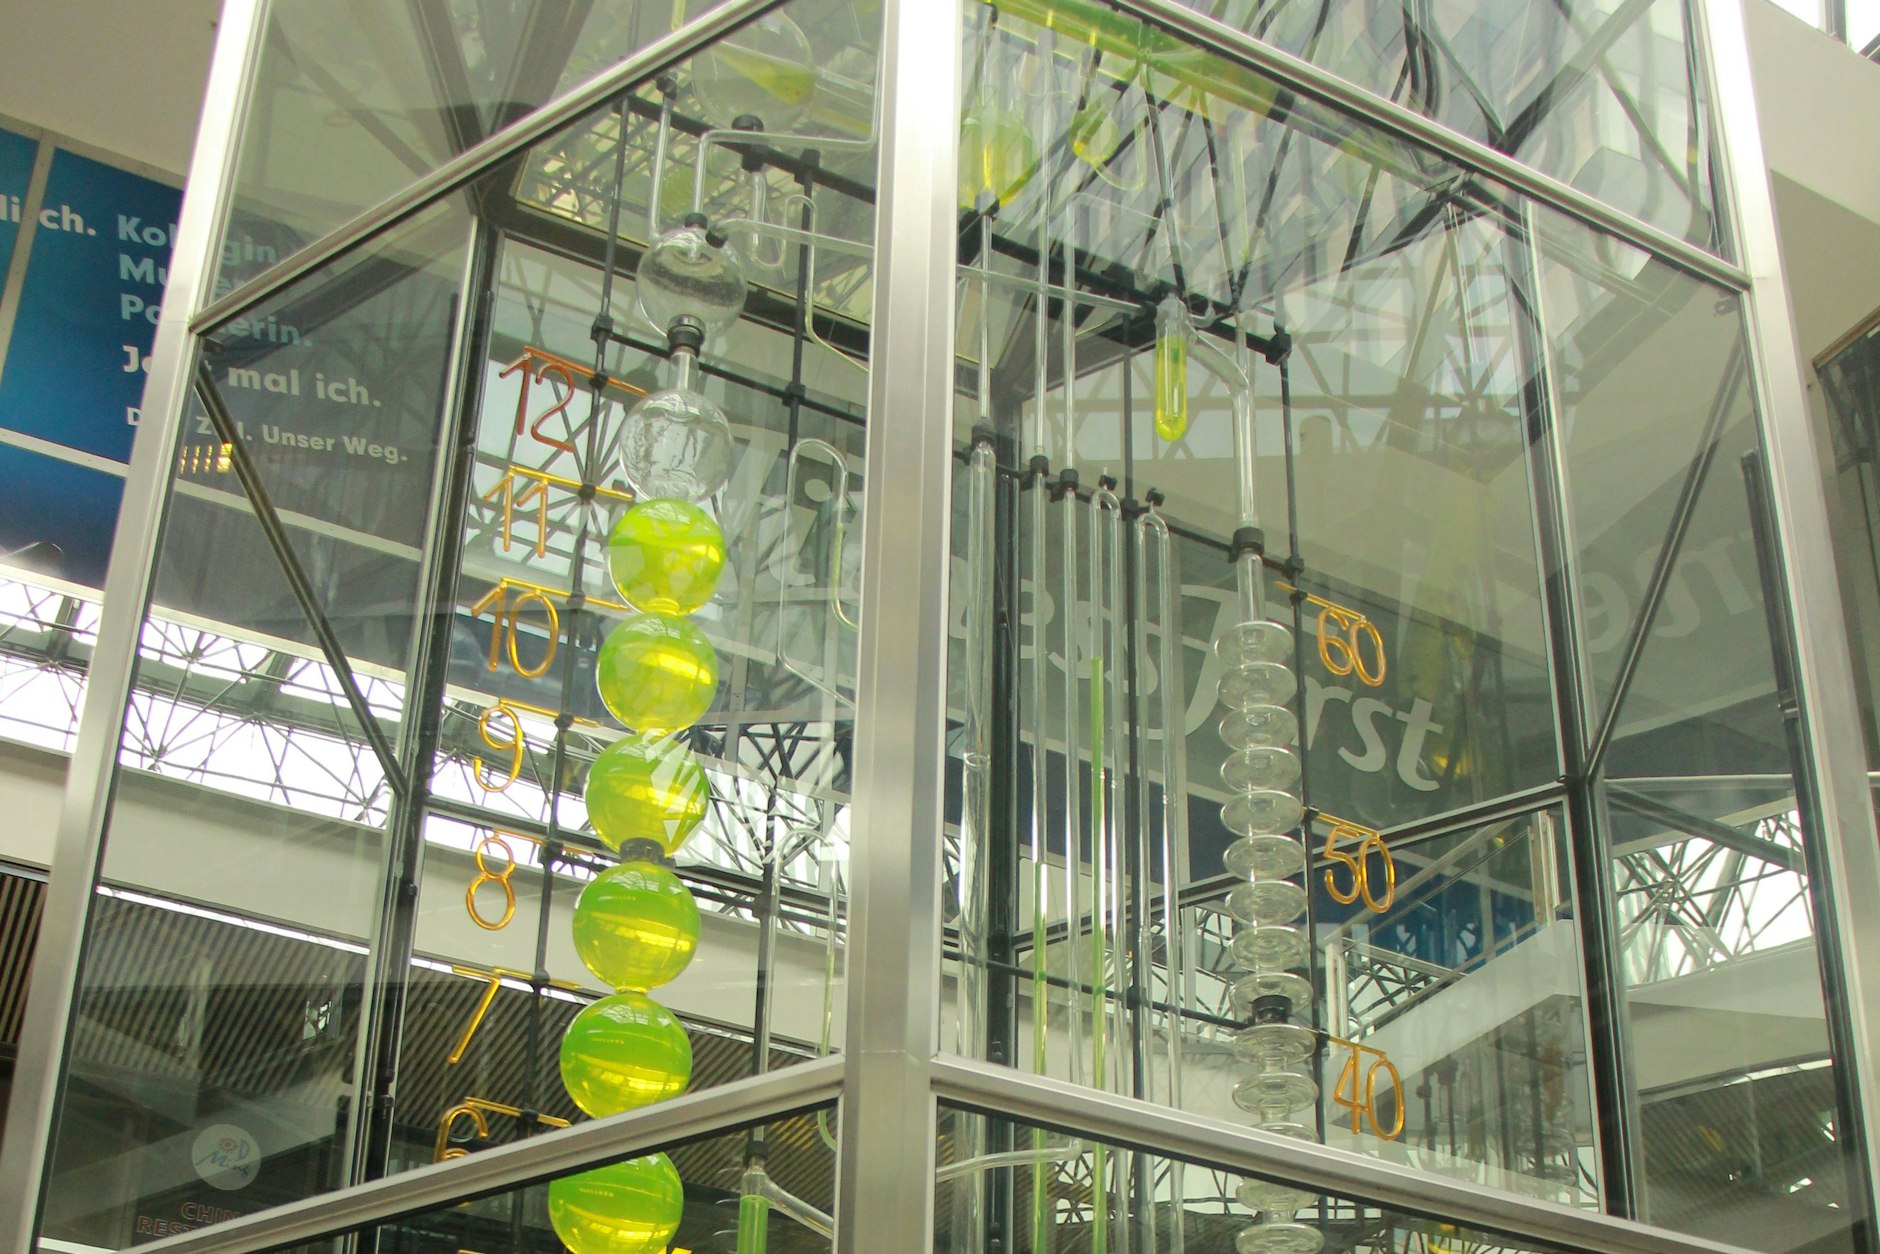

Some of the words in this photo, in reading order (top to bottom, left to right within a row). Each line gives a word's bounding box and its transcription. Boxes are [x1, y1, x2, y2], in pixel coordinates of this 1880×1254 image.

[227, 366, 300, 396] mal
[315, 373, 382, 408] ich.
[499, 352, 575, 453] 12
[262, 424, 336, 452] Unser
[342, 435, 408, 465] Weg.
[483, 470, 549, 558] 11
[471, 584, 560, 677] 10
[1317, 605, 1387, 687] 60
[474, 704, 525, 793] 9
[466, 835, 515, 931] 8
[1324, 827, 1396, 914] 50
[448, 964, 501, 1064] 7
[1333, 1049, 1406, 1141] 40
